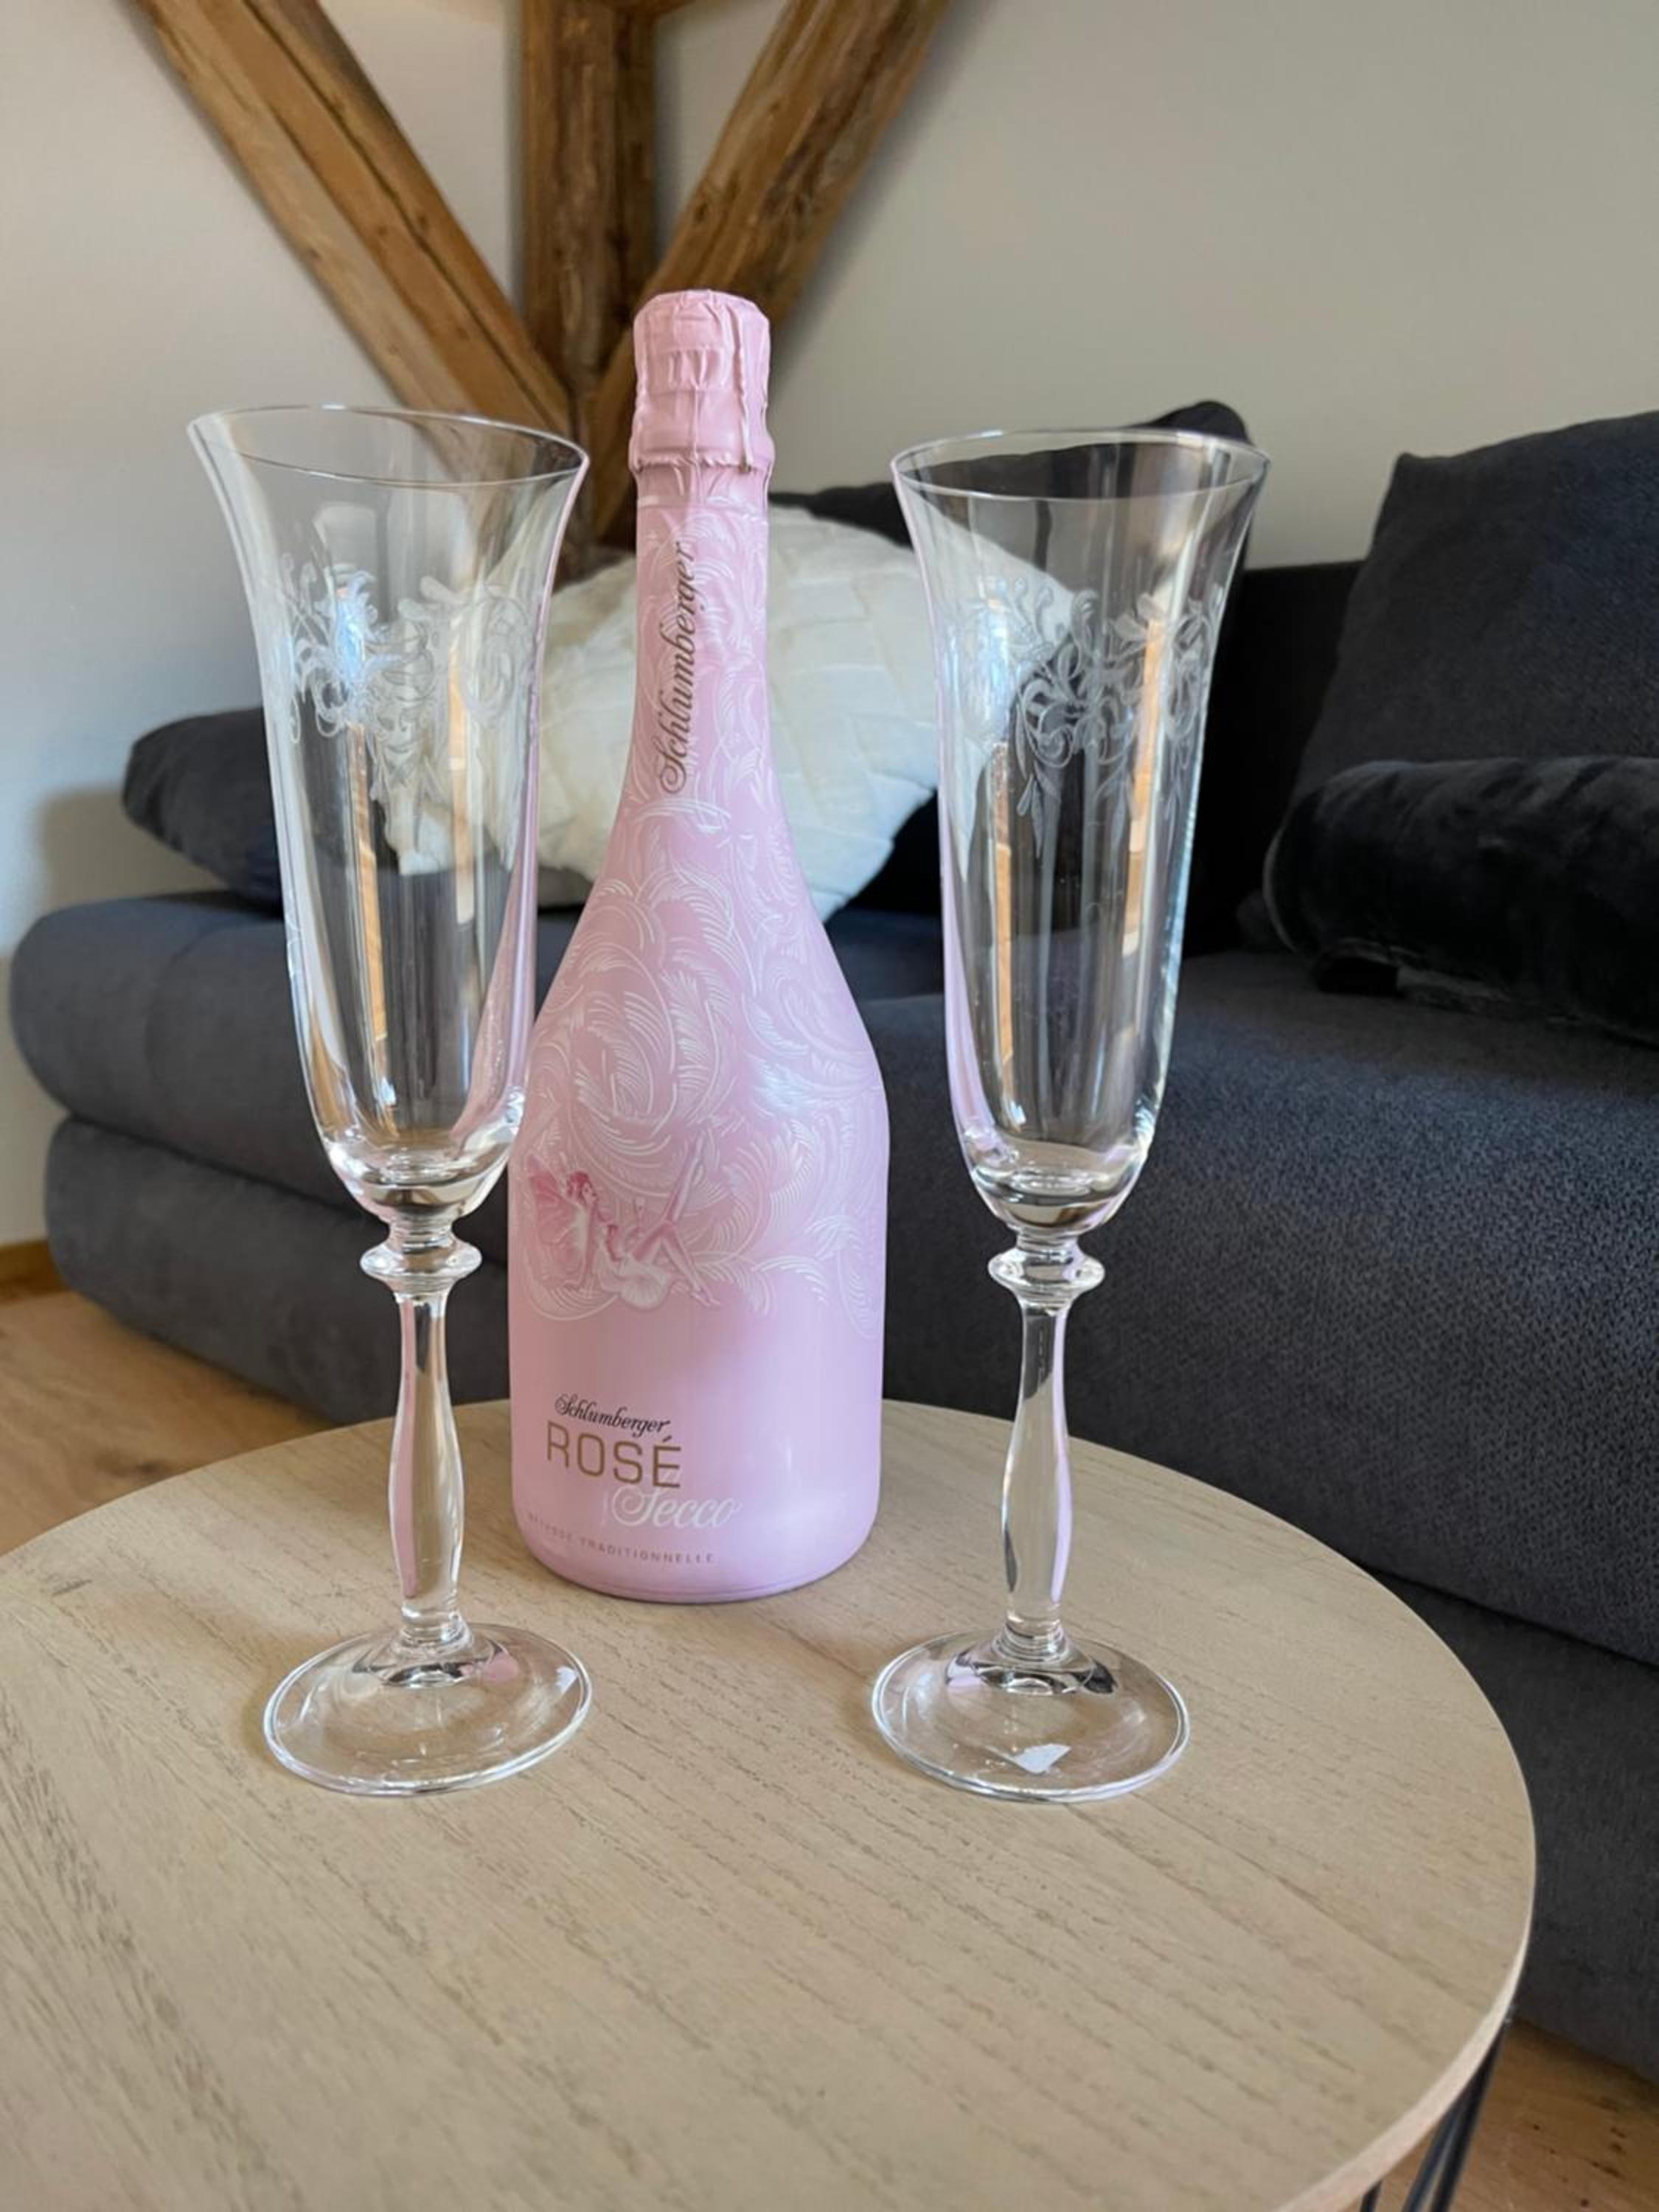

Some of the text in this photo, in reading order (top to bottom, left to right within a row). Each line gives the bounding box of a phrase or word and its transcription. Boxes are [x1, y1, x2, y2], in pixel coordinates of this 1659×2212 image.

[654, 542, 704, 794] Schlumberger
[554, 1393, 671, 1438] Schlumberger
[546, 1420, 681, 1488] ROSÉ
[611, 1478, 742, 1528] Secco
[579, 1537, 714, 1564] TRADITIONNELLE
